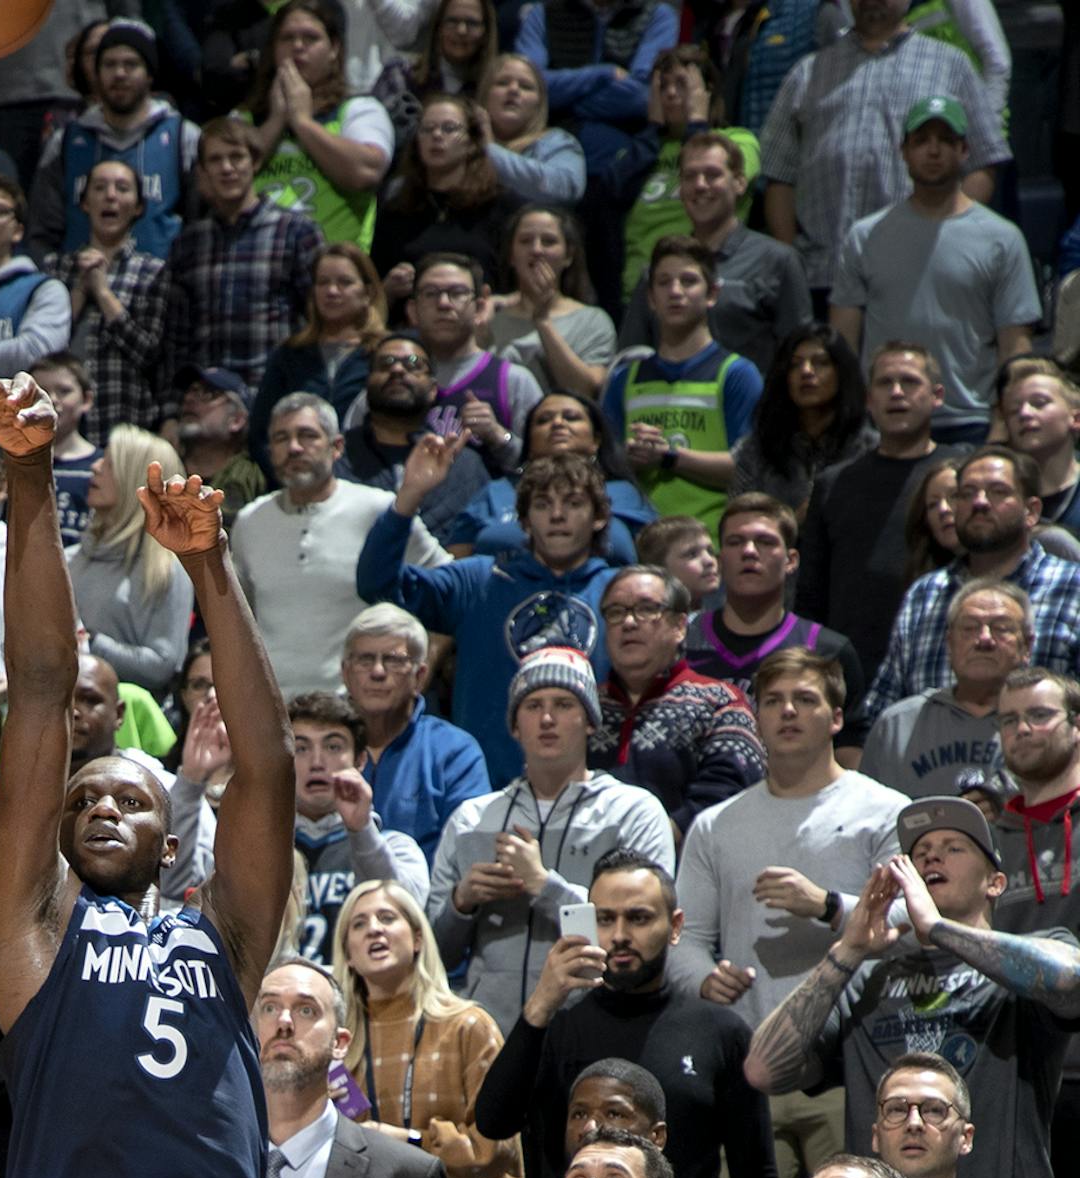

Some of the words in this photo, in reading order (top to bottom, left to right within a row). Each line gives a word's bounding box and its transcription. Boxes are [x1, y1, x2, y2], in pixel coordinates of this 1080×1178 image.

[911, 739, 1000, 778] MINNES
[81, 941, 223, 1001] MINNSOT
[136, 995, 188, 1080] 5
